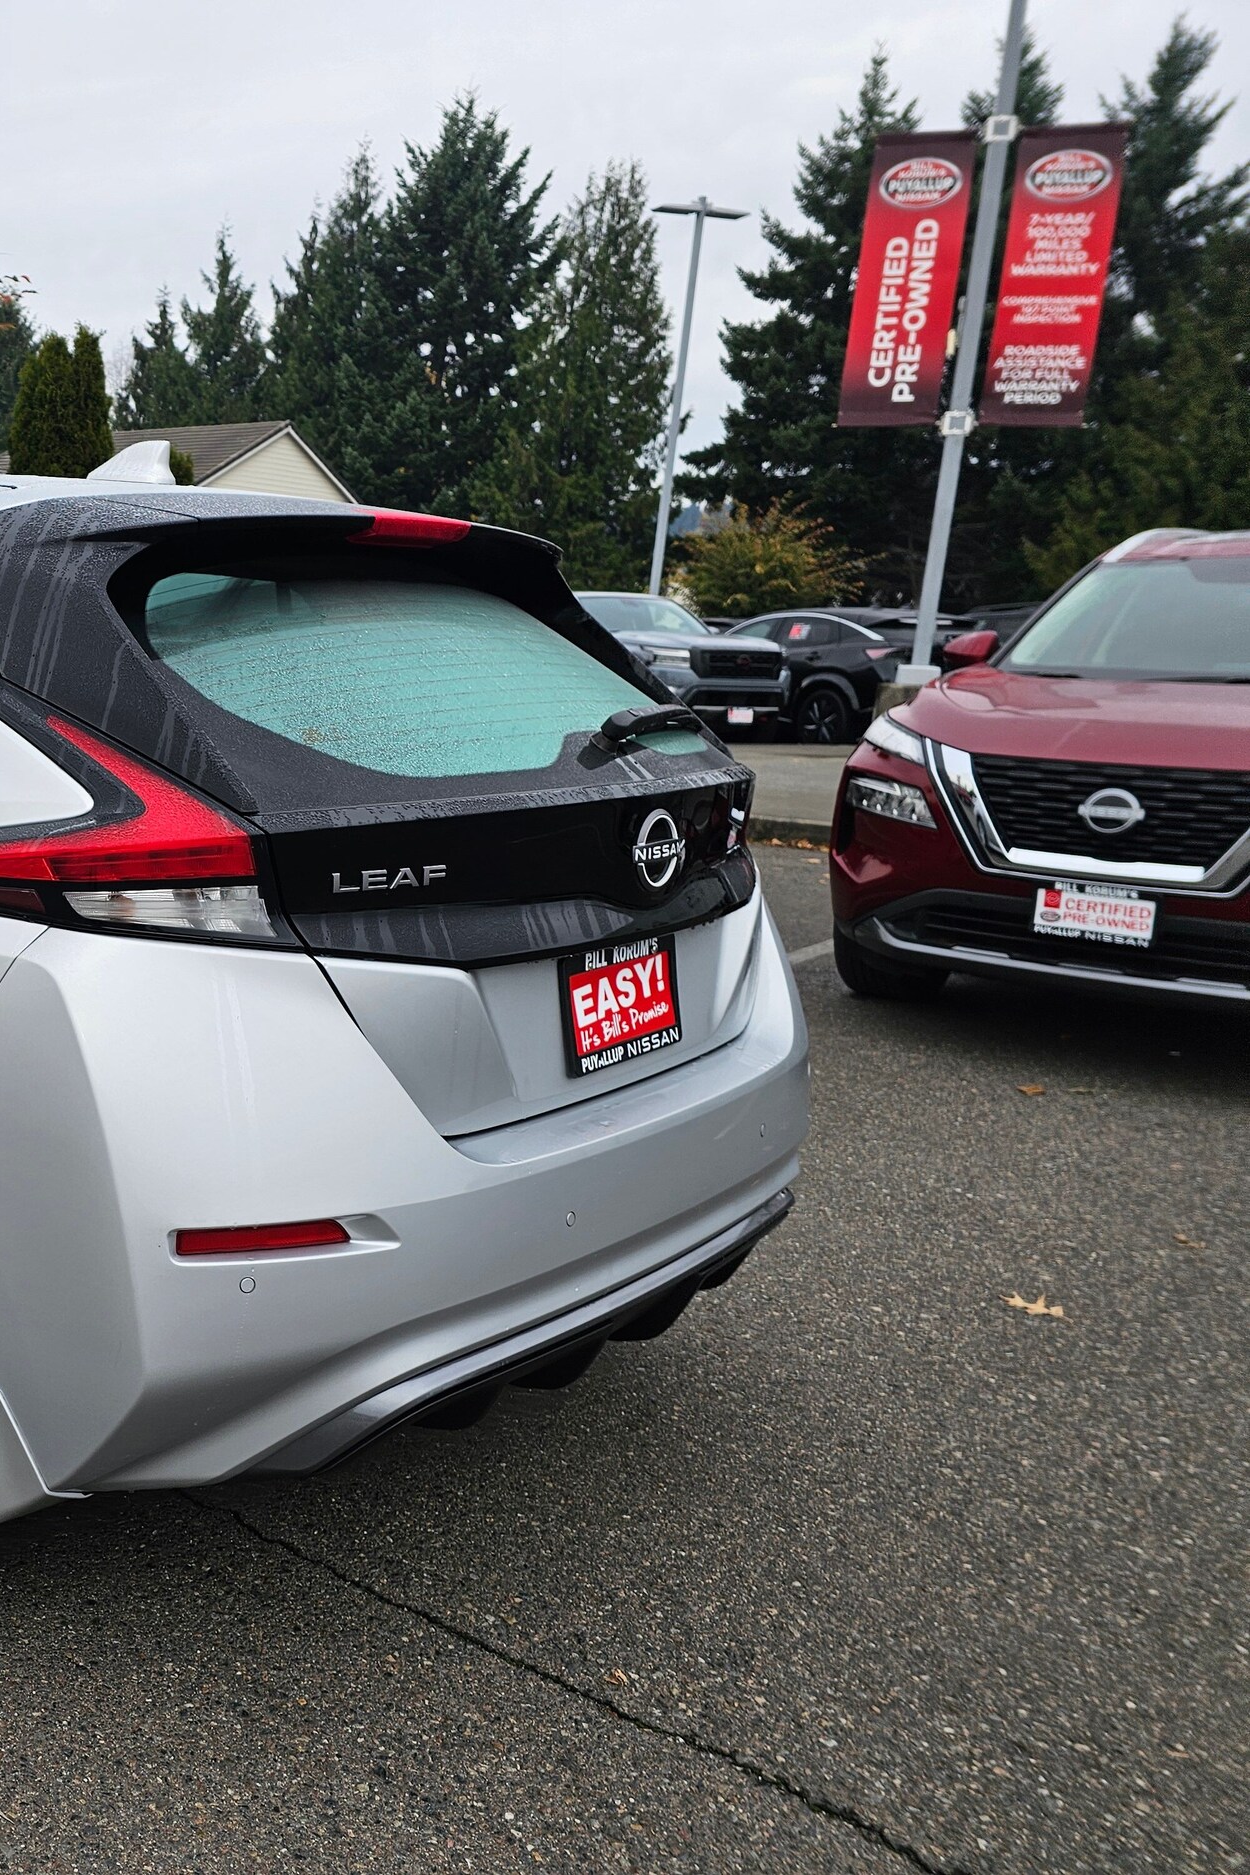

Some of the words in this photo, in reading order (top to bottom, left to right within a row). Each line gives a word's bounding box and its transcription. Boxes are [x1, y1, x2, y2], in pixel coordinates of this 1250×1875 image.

[888, 176, 954, 193] PUYALLUP
[1033, 238, 1083, 250] MILES
[1024, 250, 1089, 263] LIMITED
[1010, 262, 1100, 276] WARRANTY
[867, 236, 910, 388] CERTIFIED
[891, 218, 940, 403] PRE-OWNED
[1003, 344, 1081, 356] ROADSIDE
[993, 356, 1086, 369] ASSISTANCE
[1001, 368, 1033, 379] FOR
[1035, 368, 1071, 380] FULL
[994, 380, 1080, 393] WARRANTY
[1002, 392, 1062, 404] PERIOD
[634, 838, 686, 862] NISSAN
[331, 864, 447, 893] LEAF
[1066, 897, 1151, 919] CERTIFIED
[1062, 911, 1150, 932] PRE-OWNED
[1084, 931, 1150, 948] NISSAN
[585, 948, 608, 971] BILL
[613, 938, 659, 964] KORUM'S
[572, 953, 666, 1029] EASY!
[580, 1027, 601, 1053] It's
[601, 1013, 630, 1042] Bill's
[629, 1001, 669, 1030] Promise
[581, 1045, 624, 1073] PUYALLUP
[627, 1027, 680, 1058] NISSAN
